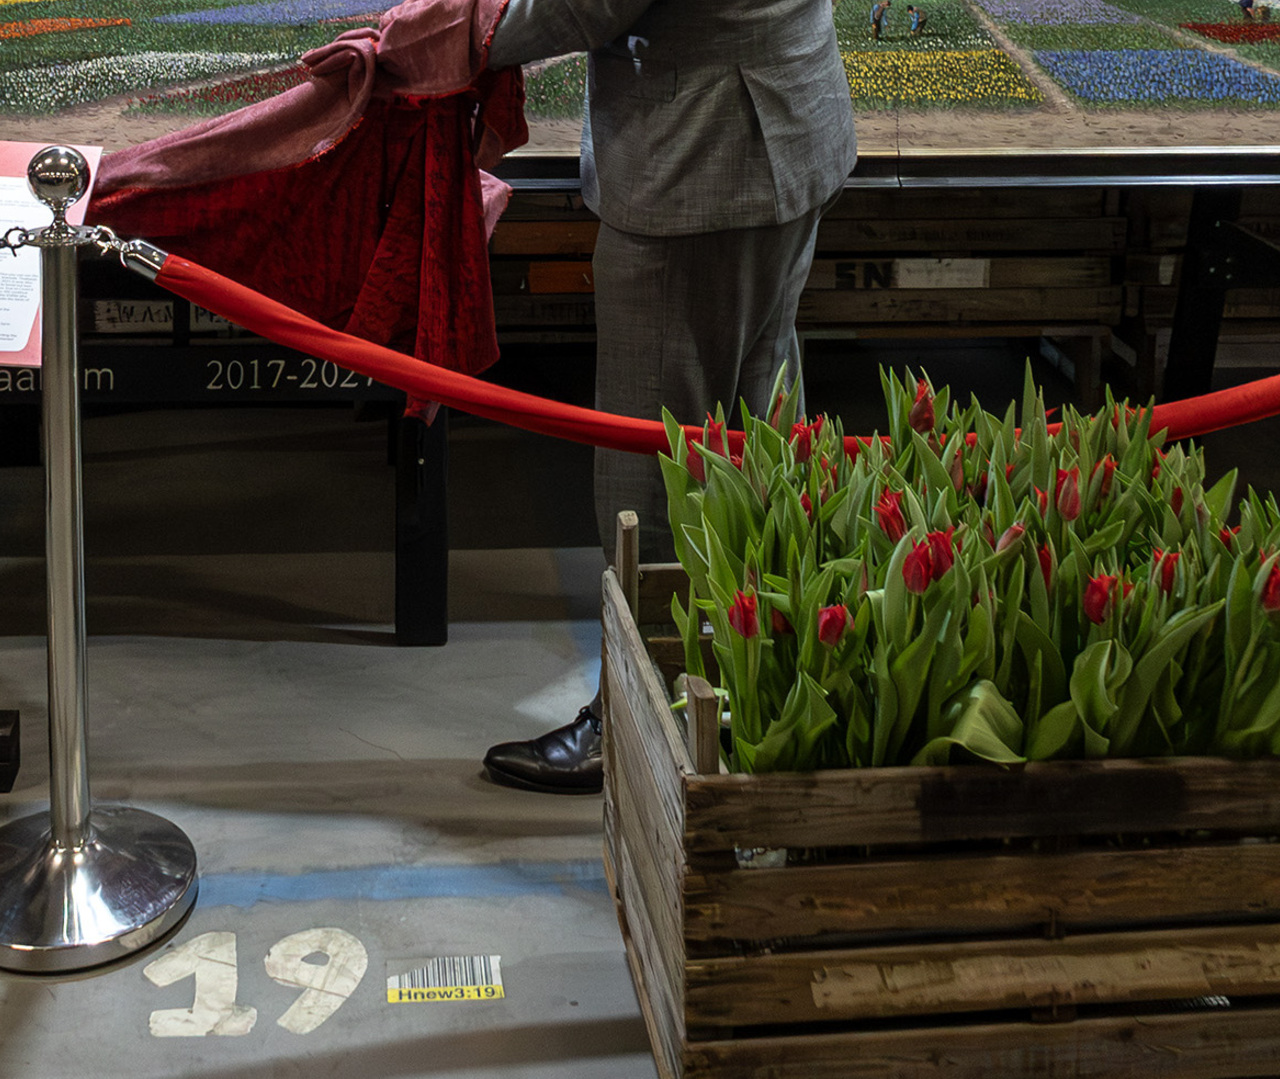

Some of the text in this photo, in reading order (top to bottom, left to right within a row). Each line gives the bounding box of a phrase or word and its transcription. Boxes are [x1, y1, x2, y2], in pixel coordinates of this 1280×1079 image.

[206, 357, 373, 391] 2017-202
[142, 926, 369, 1038] 19
[398, 985, 497, 1001] Hnew3:19
